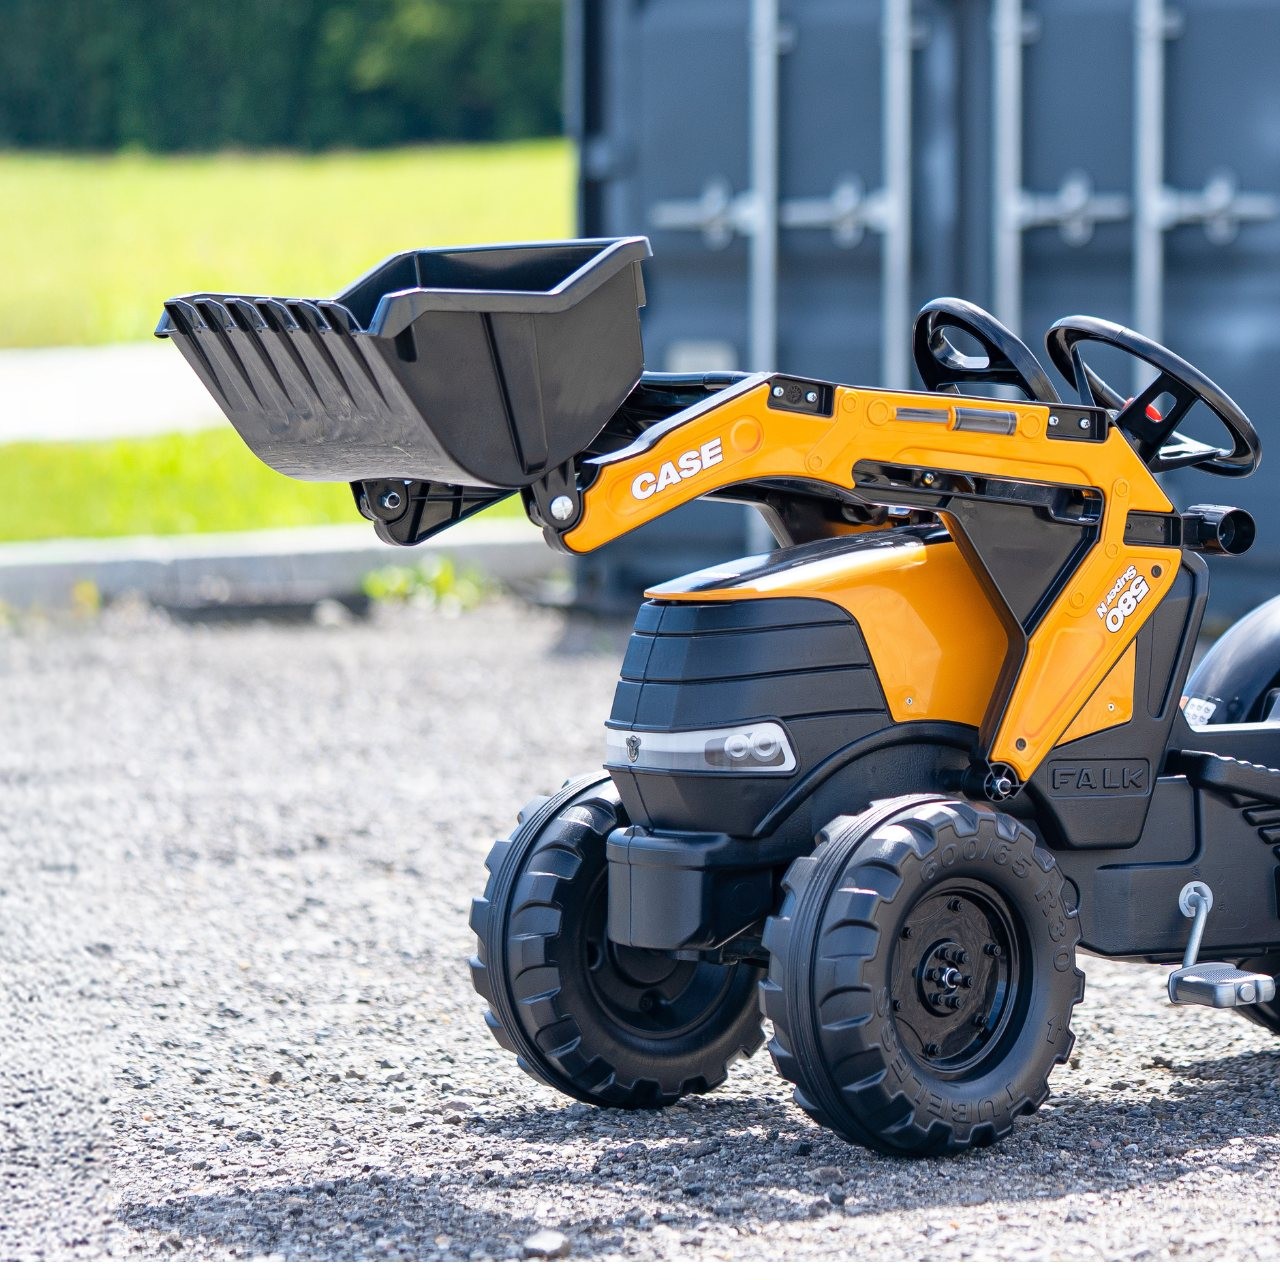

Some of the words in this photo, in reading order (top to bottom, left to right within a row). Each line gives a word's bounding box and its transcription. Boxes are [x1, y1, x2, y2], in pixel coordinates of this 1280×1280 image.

[631, 437, 724, 500] CASE
[1105, 575, 1150, 633] 580
[1106, 565, 1137, 606] Super
[1096, 601, 1108, 620] N
[1052, 767, 1145, 790] FALK
